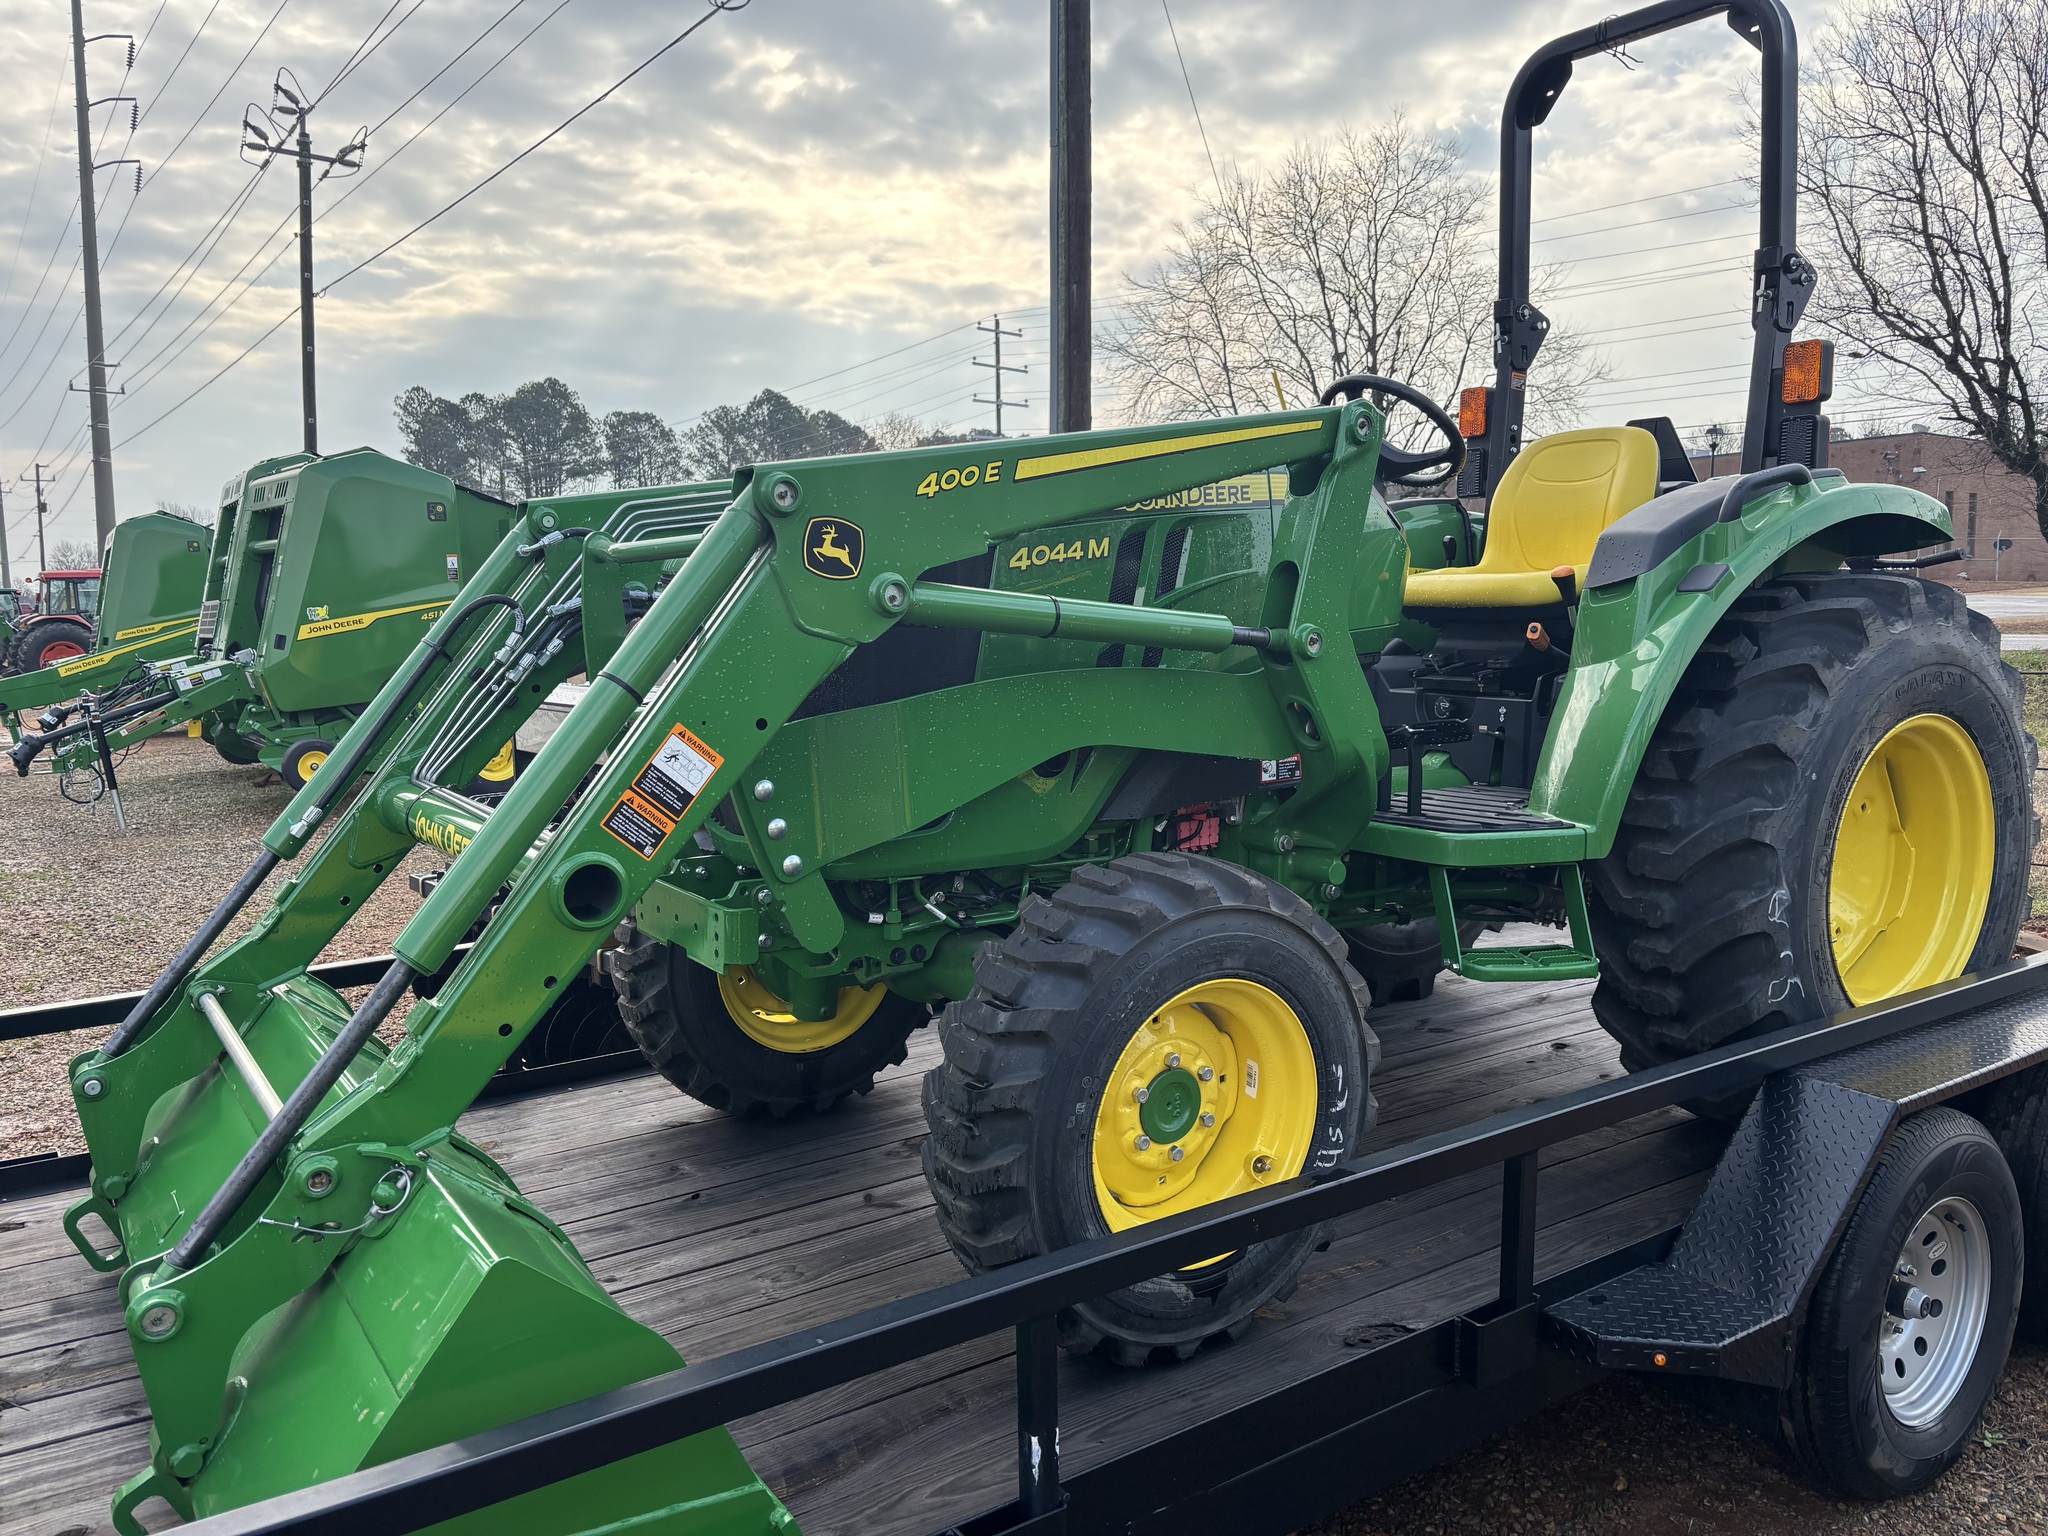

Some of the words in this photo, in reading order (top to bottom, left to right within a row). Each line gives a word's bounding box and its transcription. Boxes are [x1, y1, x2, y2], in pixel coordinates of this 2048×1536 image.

[915, 465, 980, 499] 400
[983, 460, 1004, 484] E
[1187, 485, 1253, 506] DEERE
[1008, 540, 1084, 571] 4044
[1087, 537, 1110, 560] M
[307, 624, 332, 634] JOHN
[333, 618, 364, 629] DEERE
[63, 665, 82, 673] JOHN
[82, 657, 106, 668] DEERE
[686, 735, 717, 763] WARNING
[636, 801, 669, 829] WARNING
[414, 809, 446, 851] JOHN
